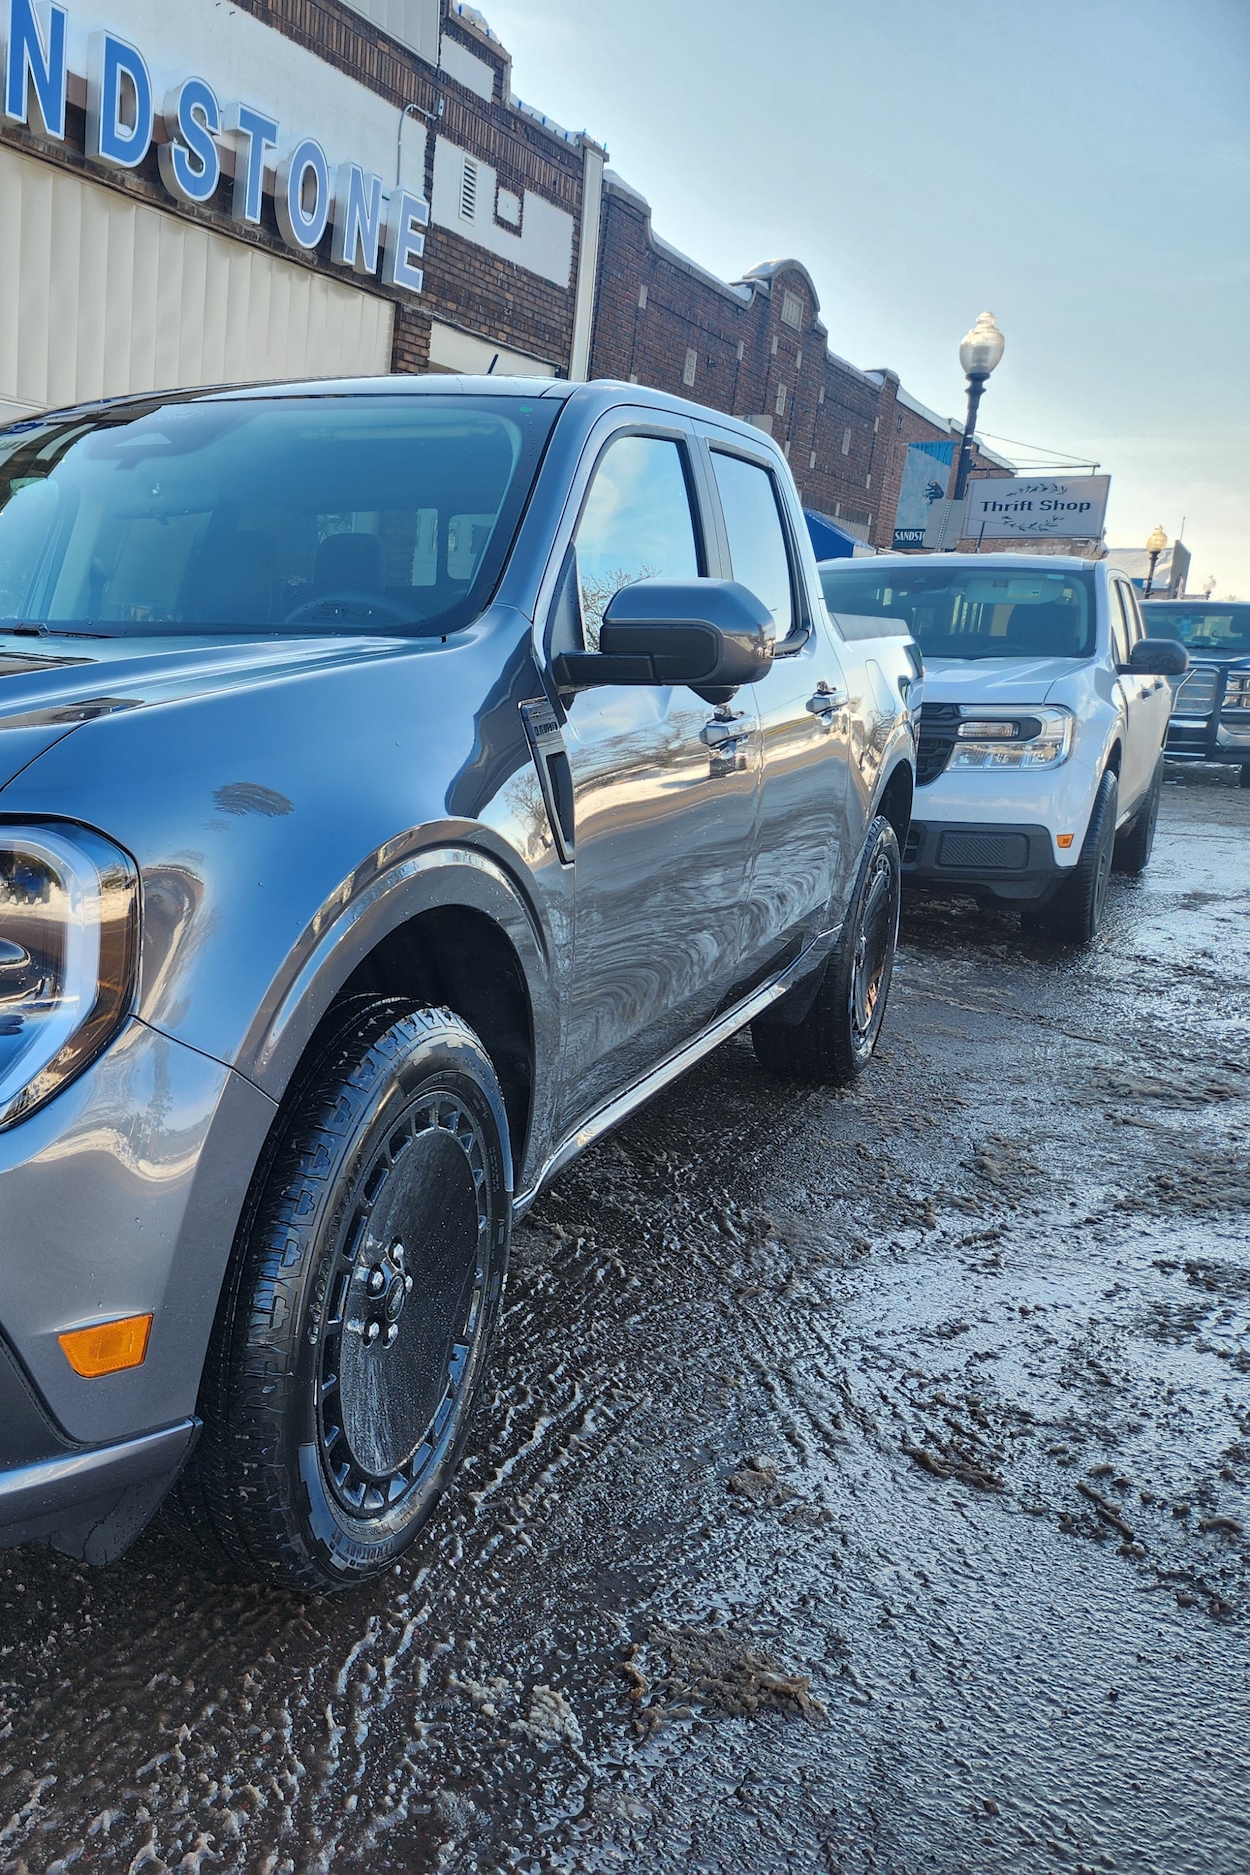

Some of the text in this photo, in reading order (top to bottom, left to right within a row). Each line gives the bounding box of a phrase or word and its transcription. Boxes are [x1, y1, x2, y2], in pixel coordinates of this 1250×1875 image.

[981, 500, 1091, 513] Thrift Shop
[895, 531, 925, 541] SANDST
